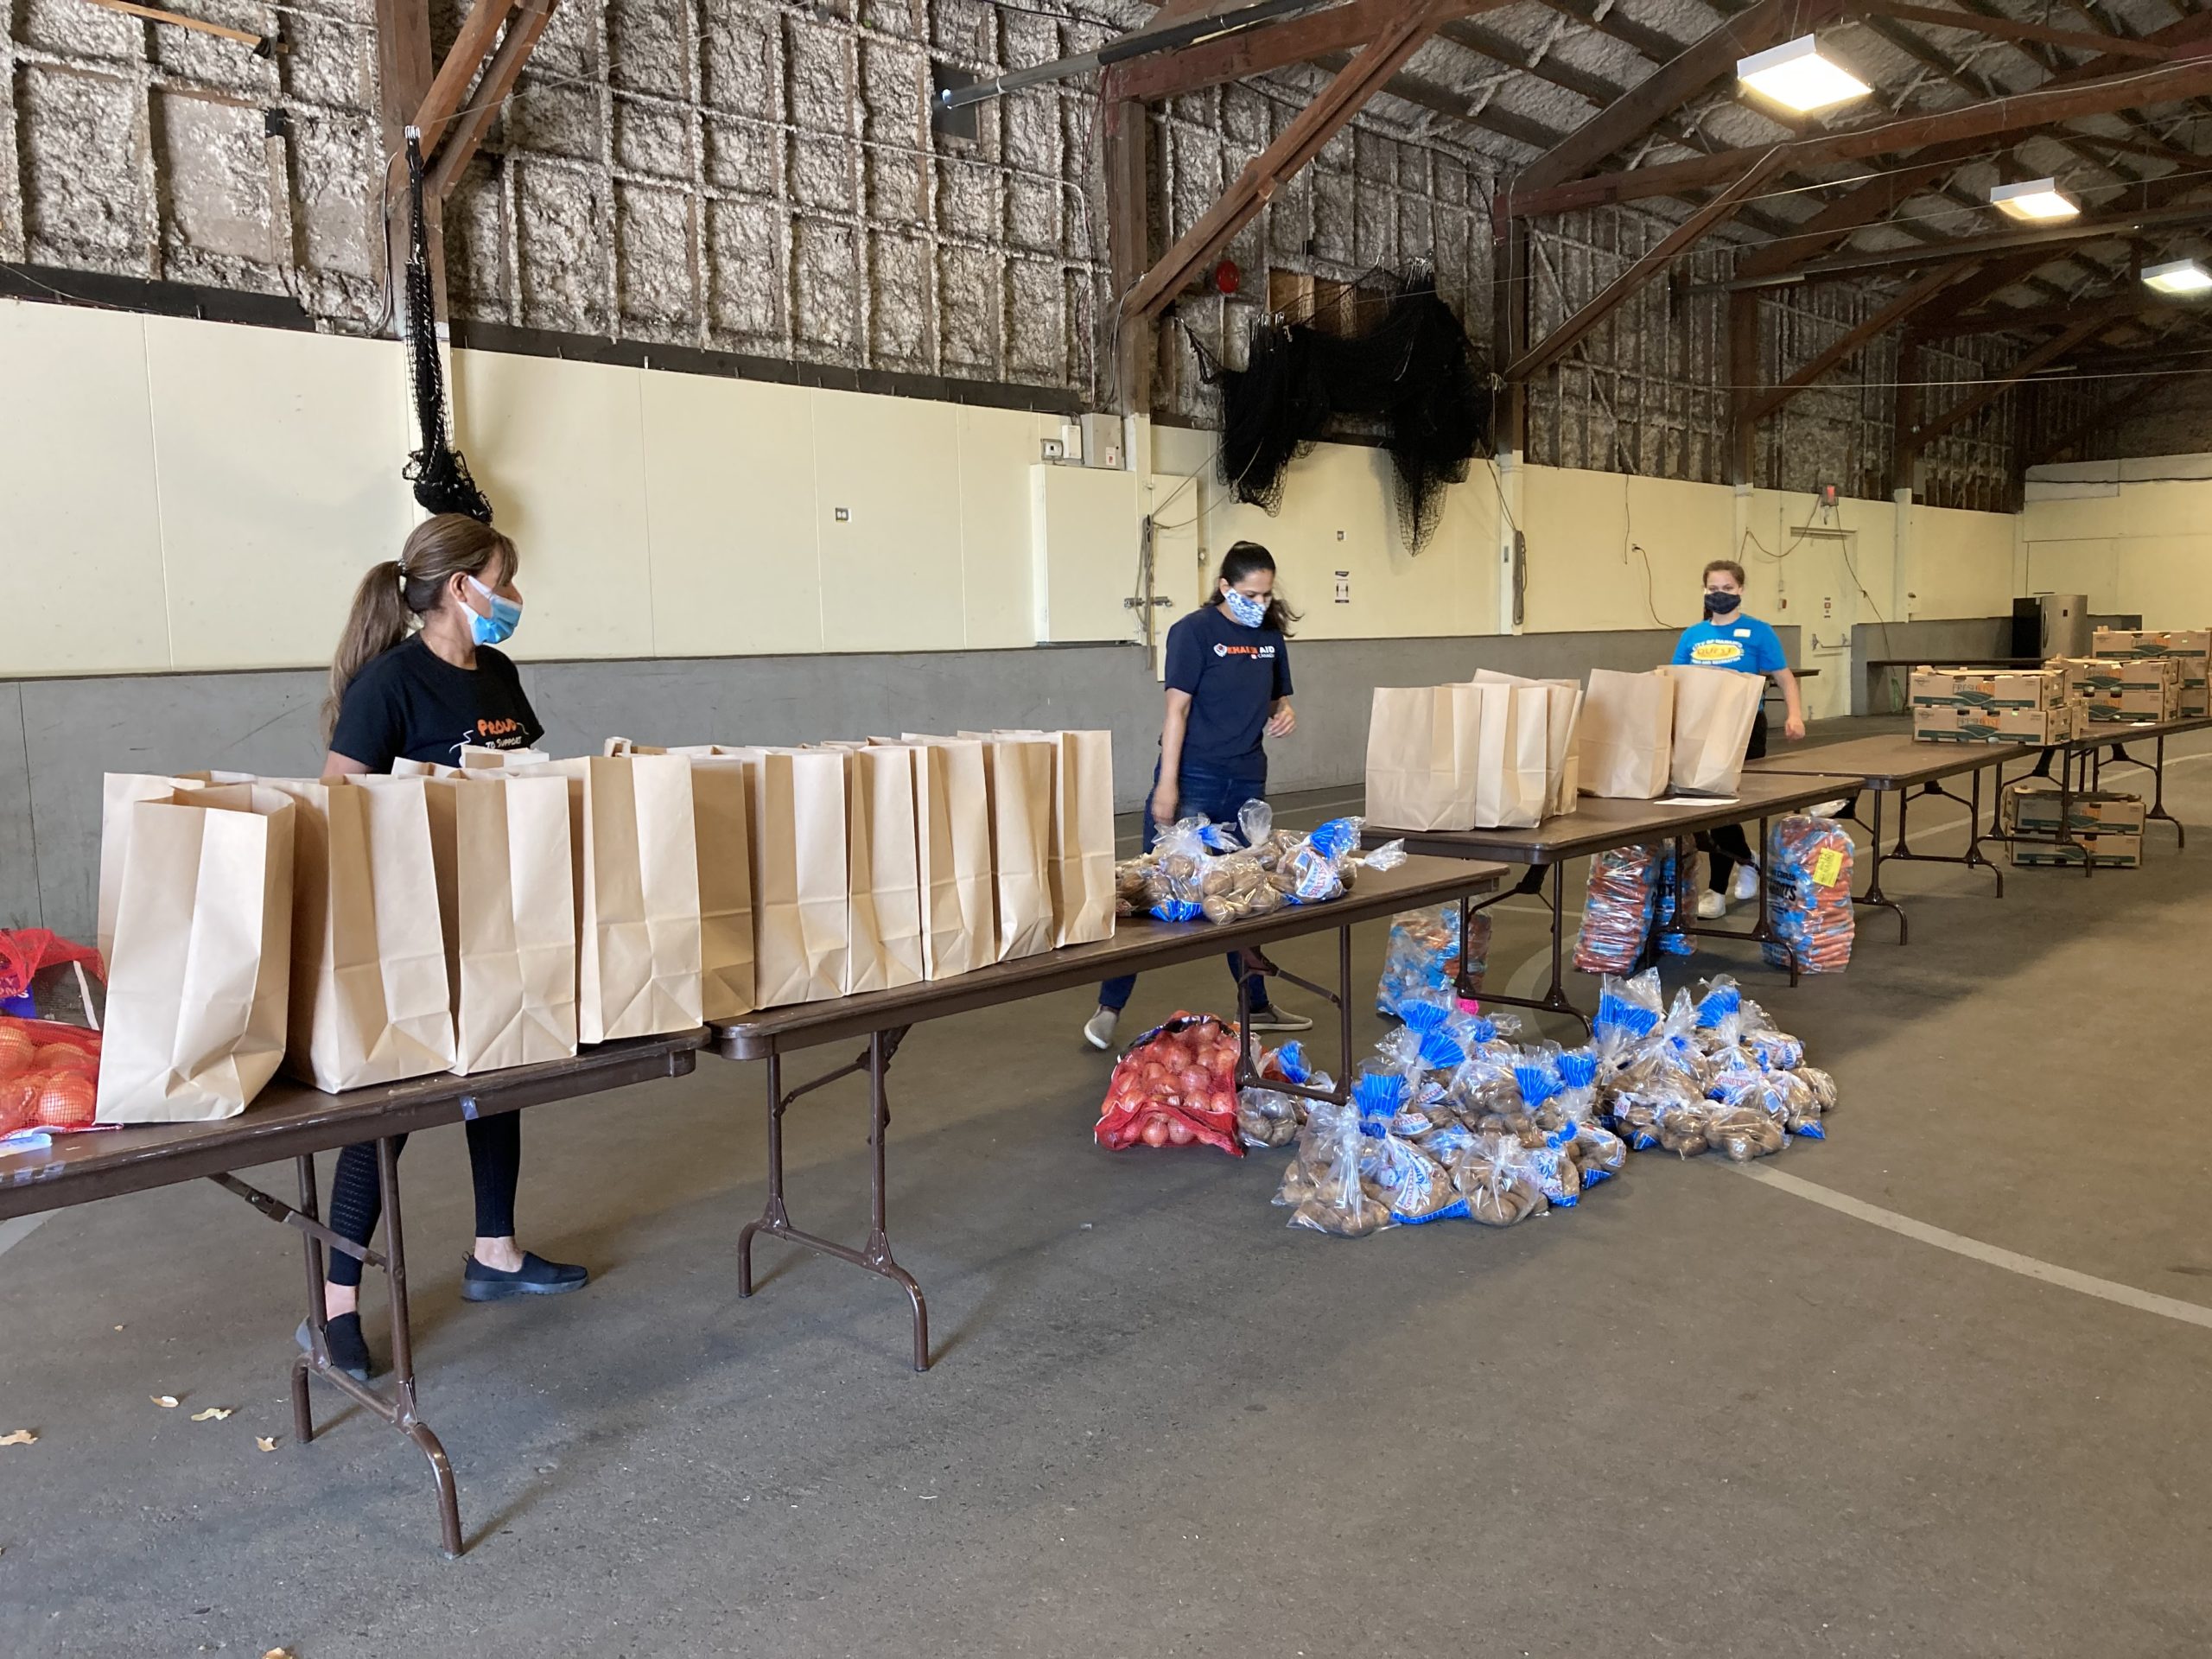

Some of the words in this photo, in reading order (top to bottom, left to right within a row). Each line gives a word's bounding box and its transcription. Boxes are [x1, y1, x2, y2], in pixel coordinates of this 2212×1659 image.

[1259, 645, 1275, 654] AID
[477, 718, 518, 737] PROUD
[496, 735, 522, 748] SUPPORT
